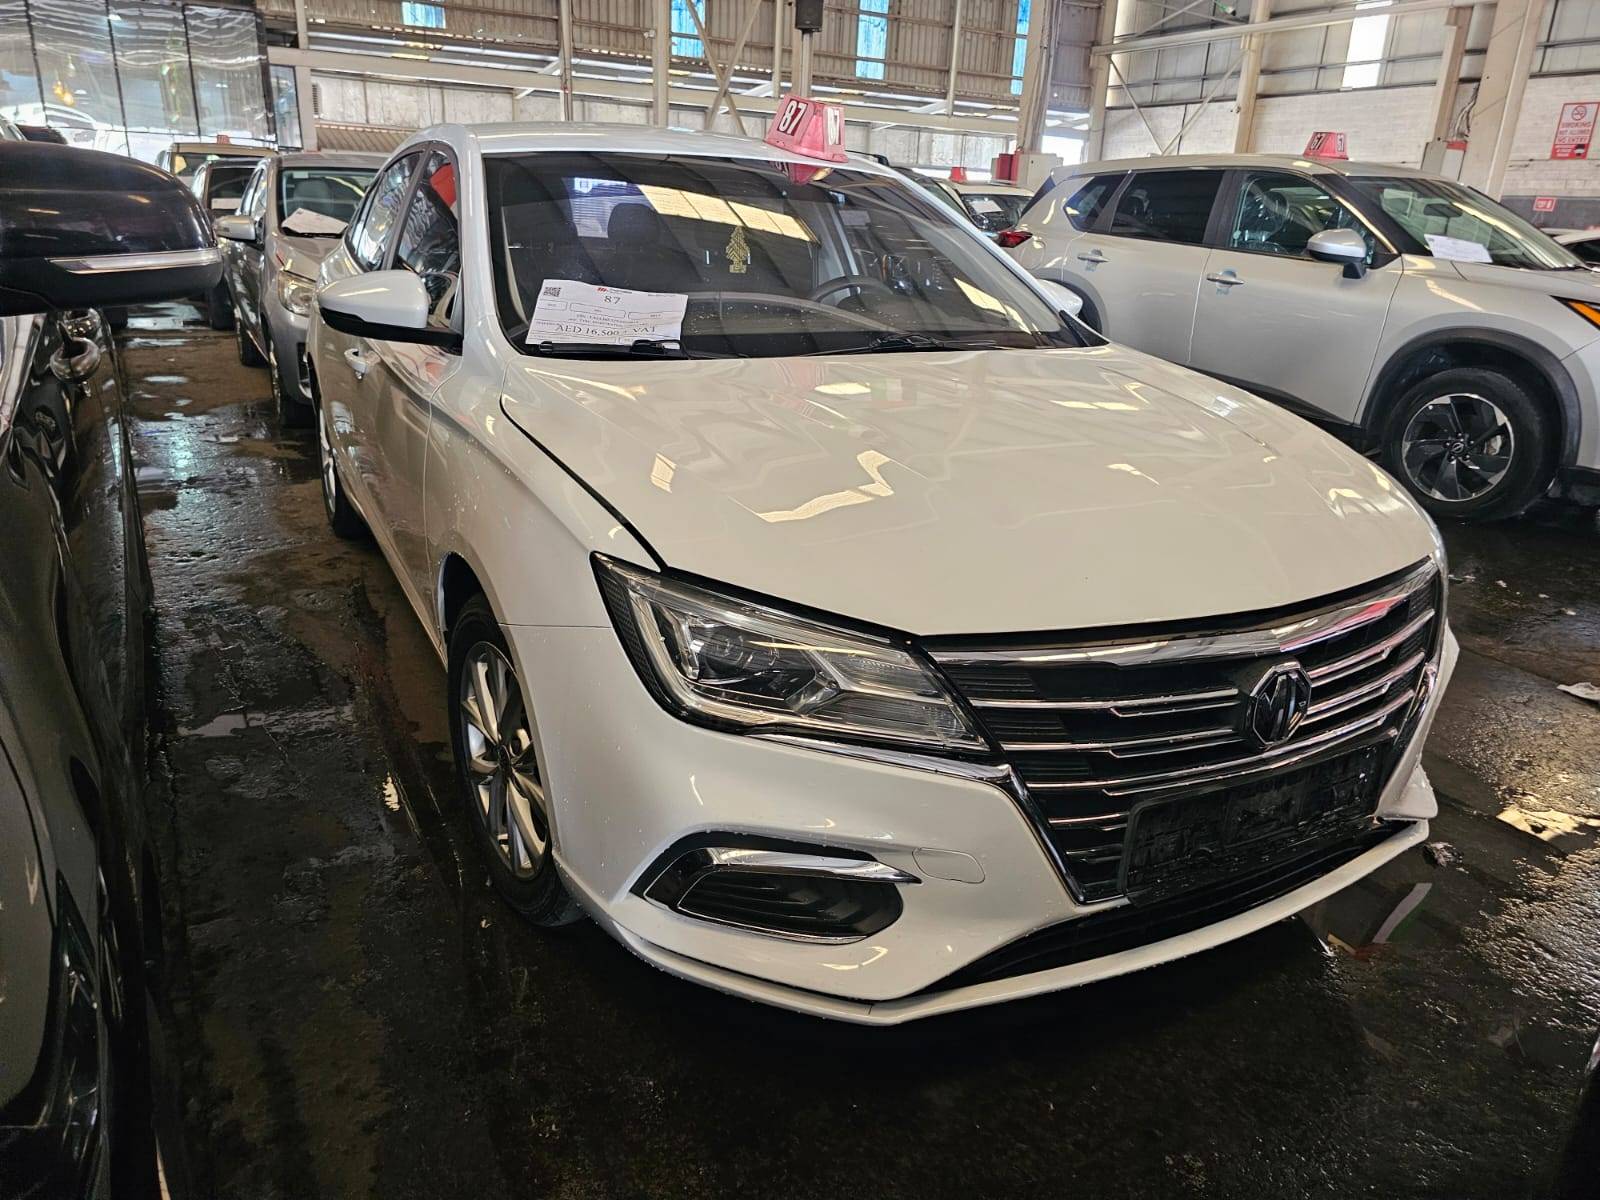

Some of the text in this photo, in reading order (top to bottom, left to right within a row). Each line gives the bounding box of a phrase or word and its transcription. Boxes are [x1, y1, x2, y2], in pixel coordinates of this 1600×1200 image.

[778, 100, 807, 135] 87
[604, 295, 621, 305] 87
[555, 325, 582, 333] AED
